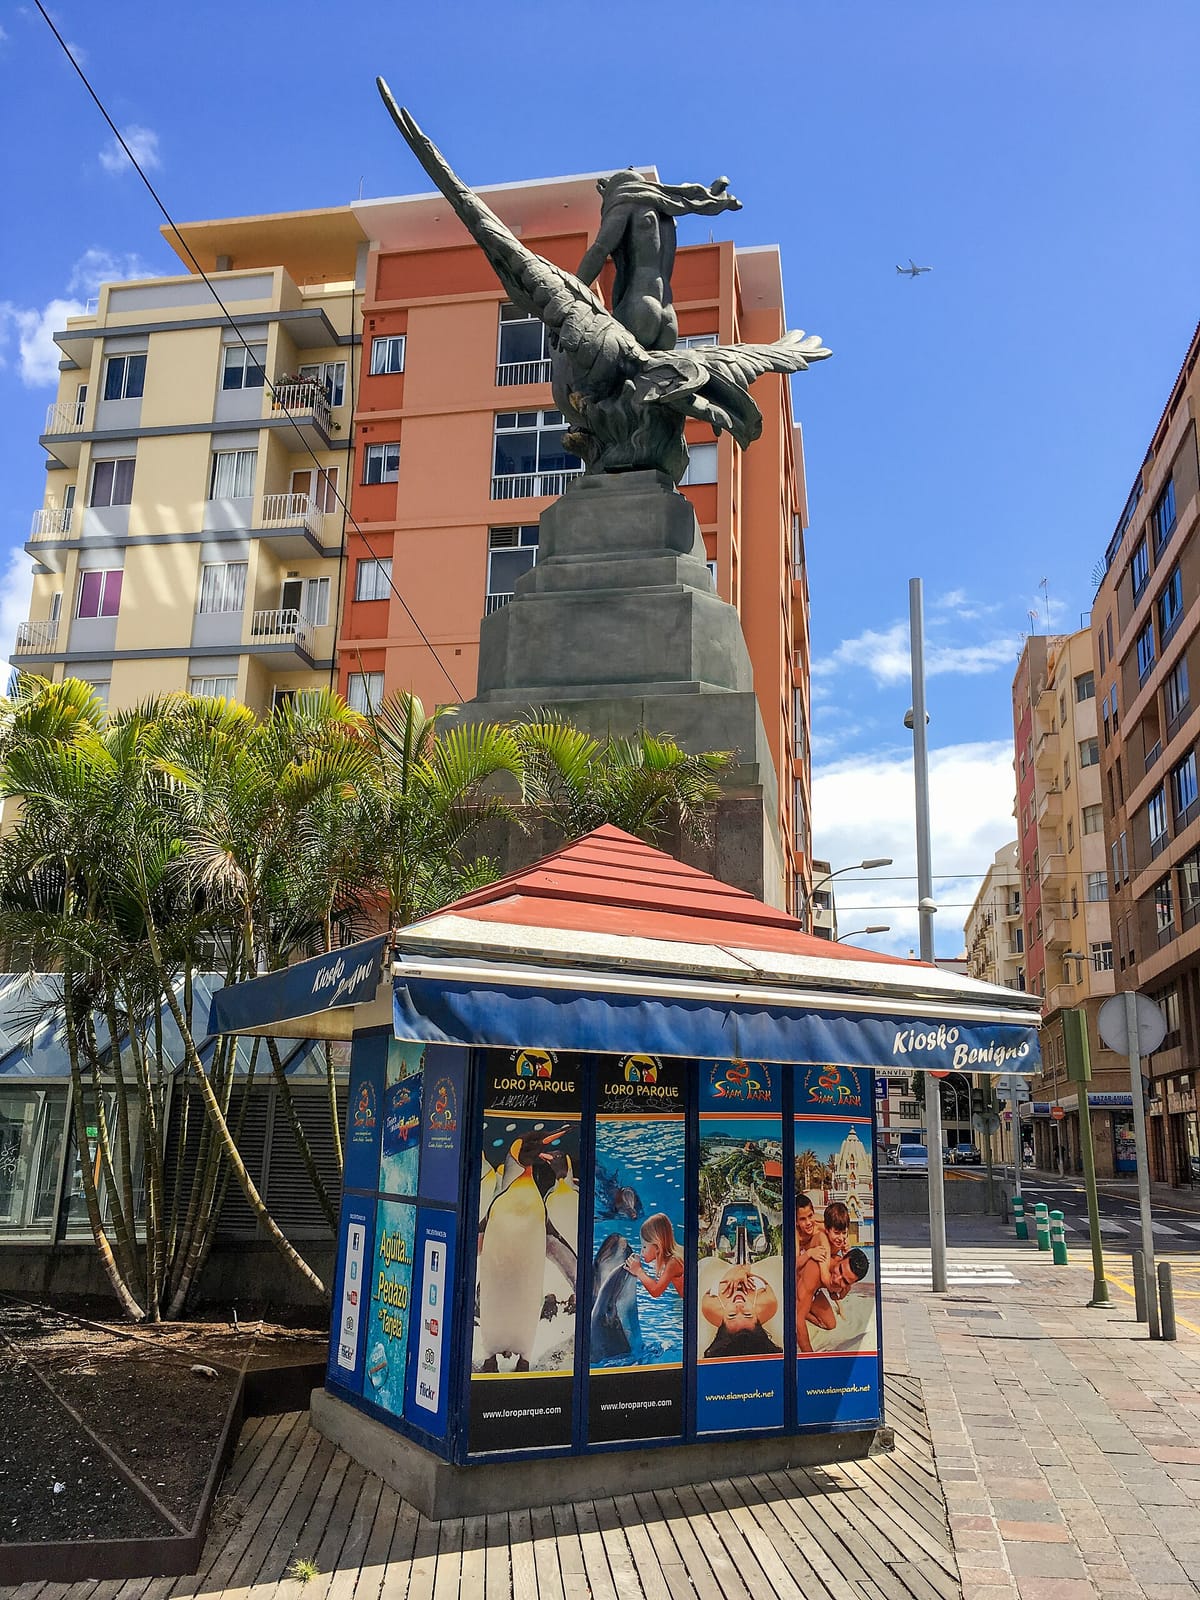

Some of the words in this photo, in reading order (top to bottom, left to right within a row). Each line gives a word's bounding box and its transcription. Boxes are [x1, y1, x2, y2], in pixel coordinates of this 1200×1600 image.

[892, 1023, 959, 1055] Kiosko
[952, 1040, 1030, 1070] Benigno
[493, 1078, 527, 1091] LORO
[529, 1079, 575, 1094] PARQUE
[604, 1083, 634, 1096] LORO
[636, 1085, 679, 1098] PARQUE
[377, 1271, 408, 1309] Pedazo
[382, 1309, 402, 1340] Tarjeta
[419, 1381, 436, 1401] flickr
[705, 1389, 775, 1402] www.siampark.net
[806, 1383, 871, 1396] www.siampark.net
[482, 1406, 562, 1419] www.loroparque.com
[600, 1399, 672, 1411] www.loroparque.com
